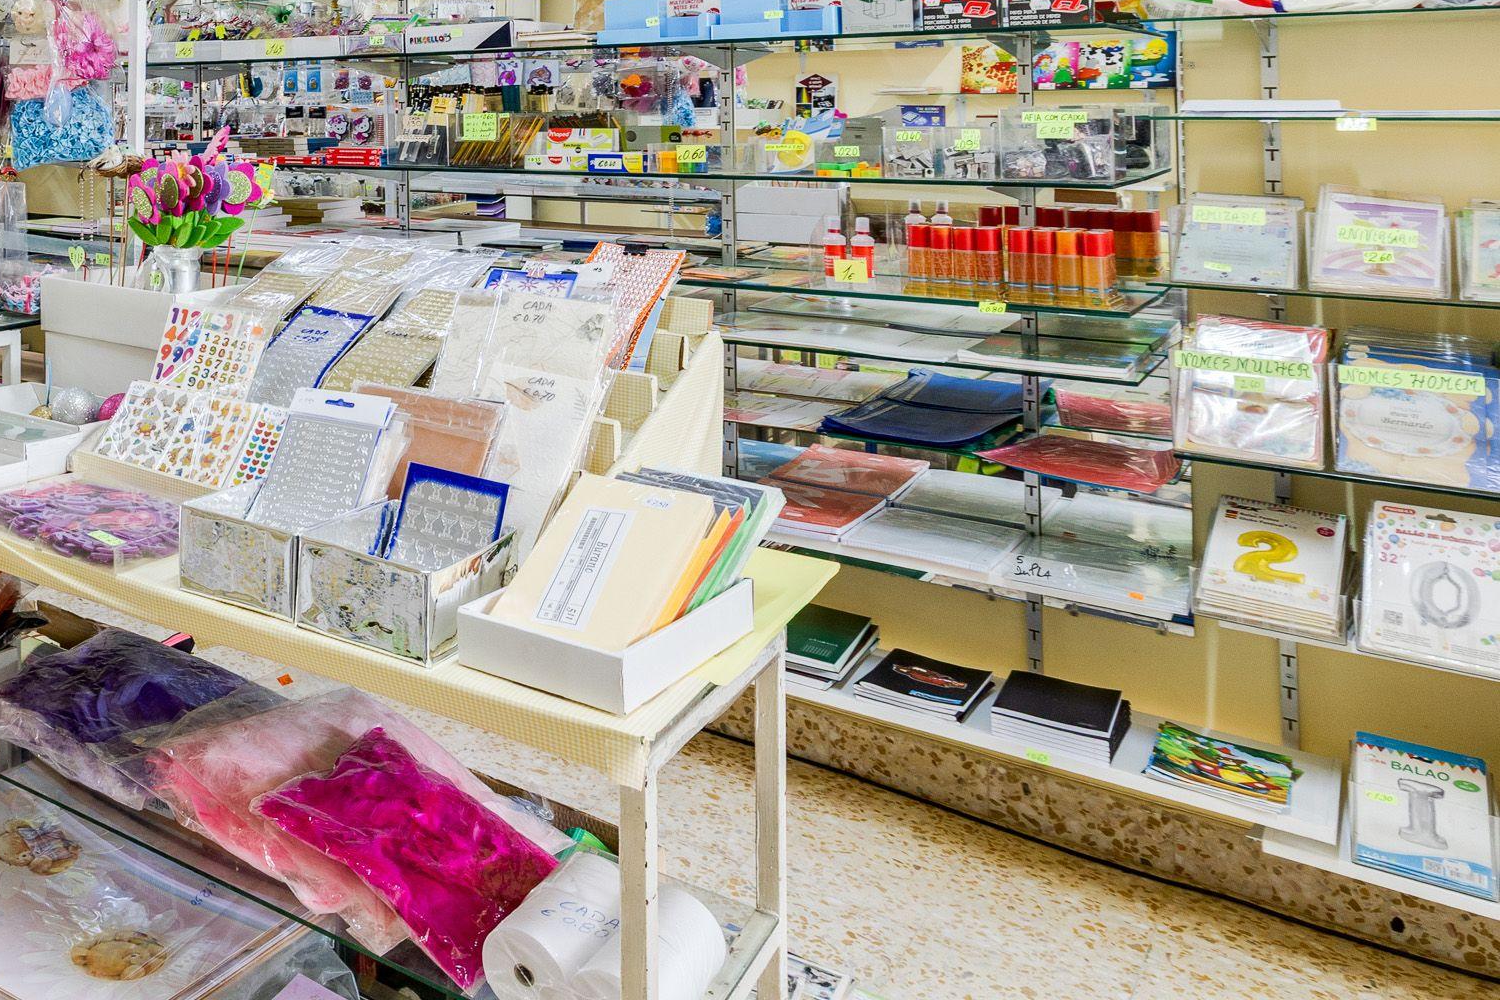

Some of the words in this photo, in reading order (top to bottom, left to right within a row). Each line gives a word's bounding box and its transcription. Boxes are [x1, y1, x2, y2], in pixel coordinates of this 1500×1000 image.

[523, 301, 553, 312] CADA
[1180, 352, 1231, 369] NOMES
[1236, 358, 1311, 378] MULHER
[528, 377, 555, 387] CADA
[1342, 369, 1403, 386] NOMES
[1410, 373, 1481, 393] HOMEM
[585, 541, 609, 574] Burano
[1233, 530, 1307, 585] 2
